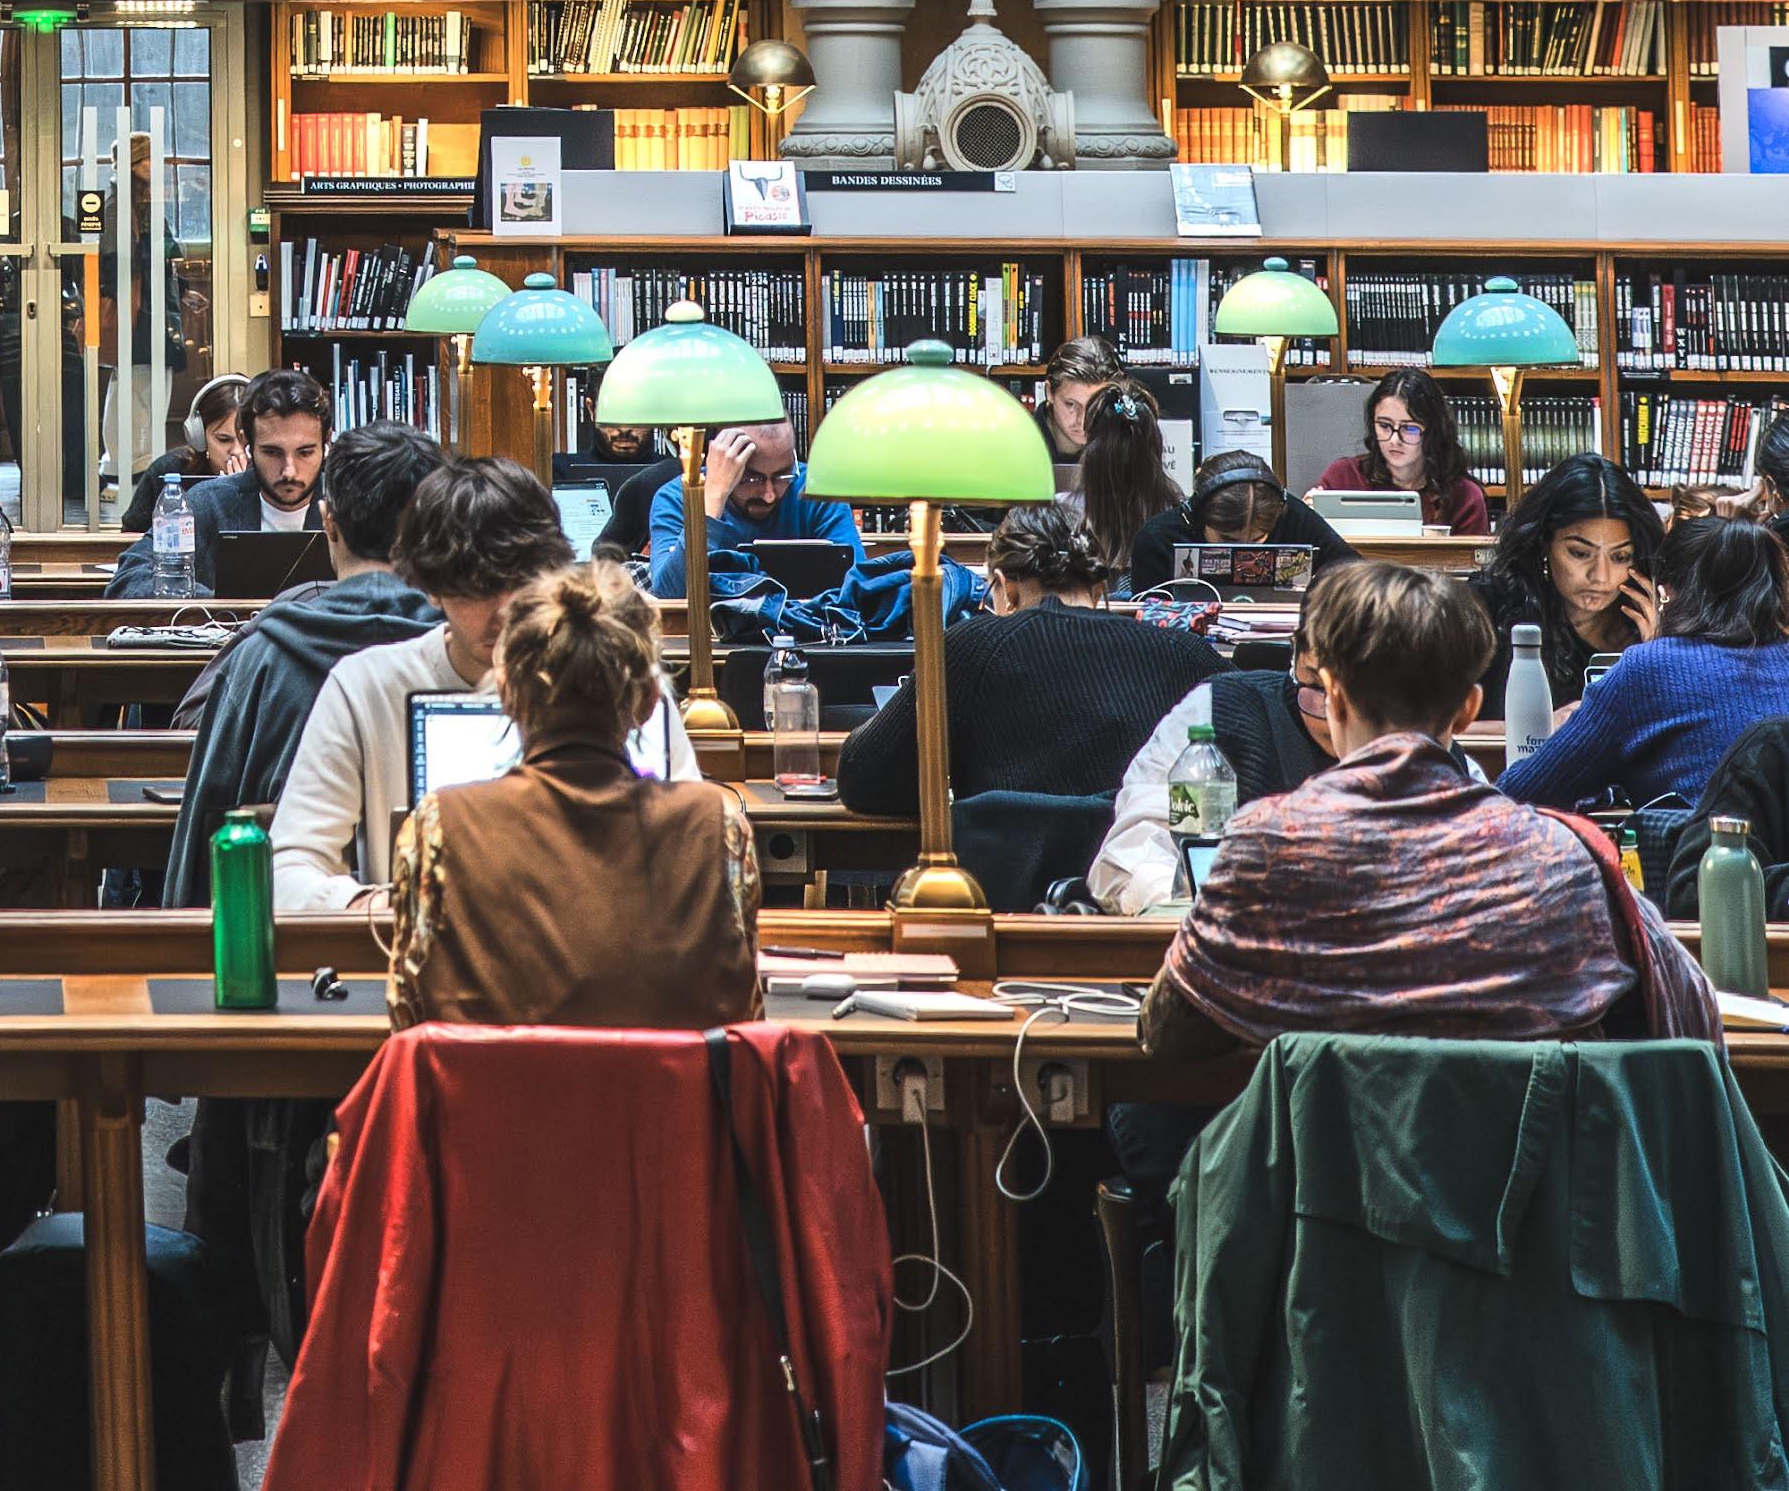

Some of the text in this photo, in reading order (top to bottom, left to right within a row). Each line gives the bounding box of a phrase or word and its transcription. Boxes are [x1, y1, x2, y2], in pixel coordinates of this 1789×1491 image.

[310, 181, 335, 190] ARTS
[336, 181, 397, 191] GRAPHIQUES
[832, 173, 942, 186] BANDES DESSINÉES
[968, 282, 977, 301] CLOCK
[1692, 415, 1704, 454] SCIENCE
[1703, 415, 1714, 454] SCIENCE
[1713, 415, 1724, 454] SCIENCE
